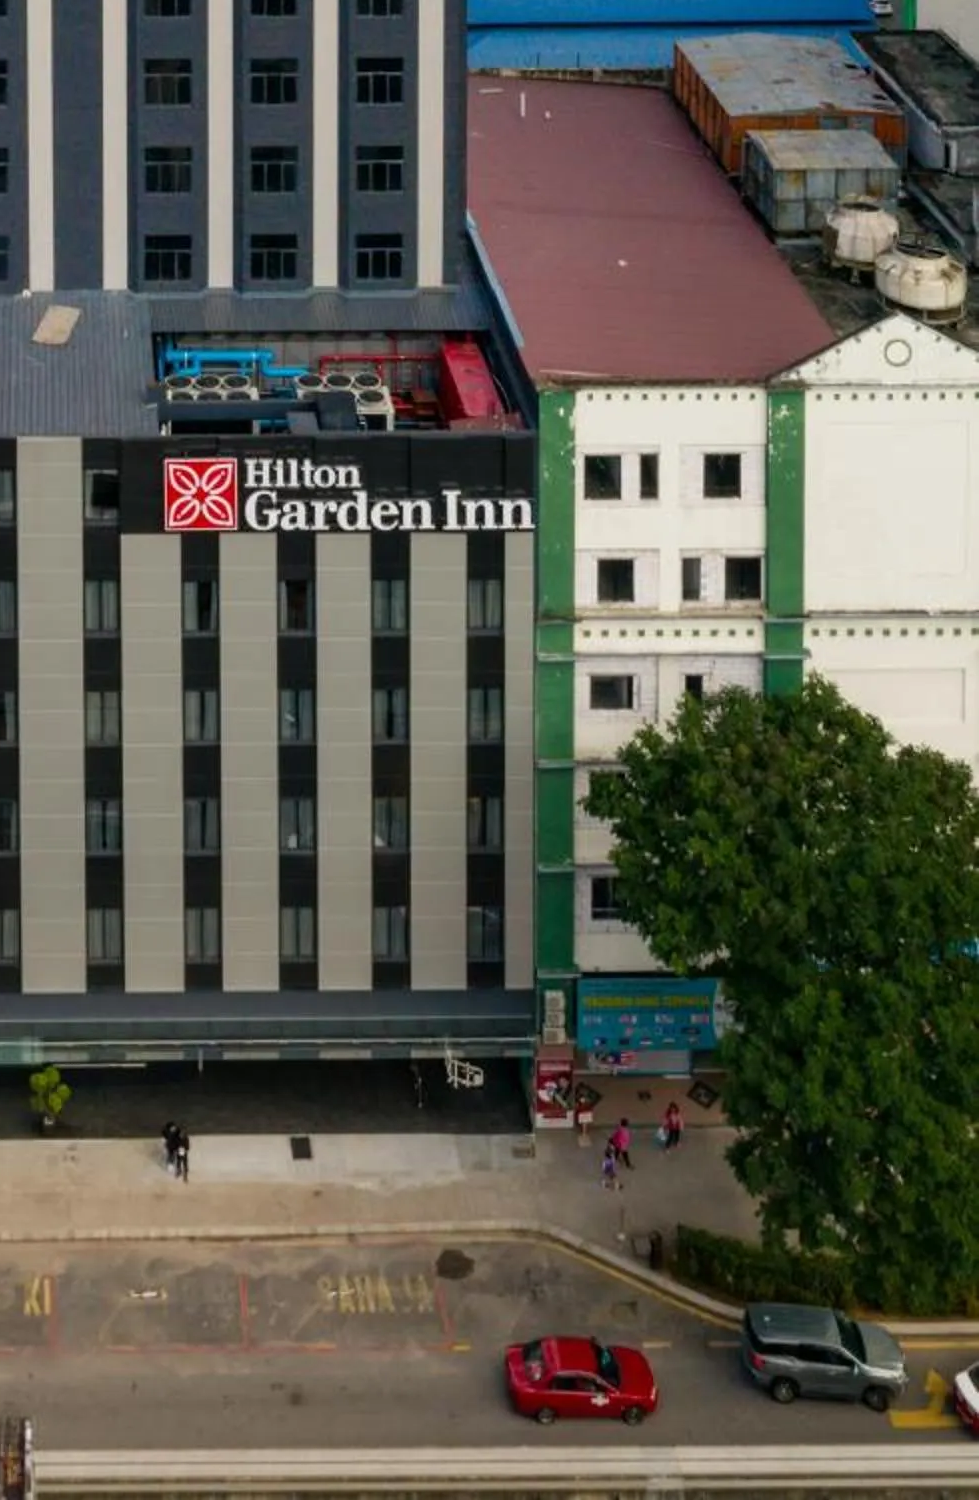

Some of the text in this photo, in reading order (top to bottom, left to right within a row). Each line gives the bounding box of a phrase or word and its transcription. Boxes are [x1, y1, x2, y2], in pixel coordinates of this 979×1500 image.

[244, 458, 362, 489] Hilton
[244, 489, 535, 531] Garden Inn
